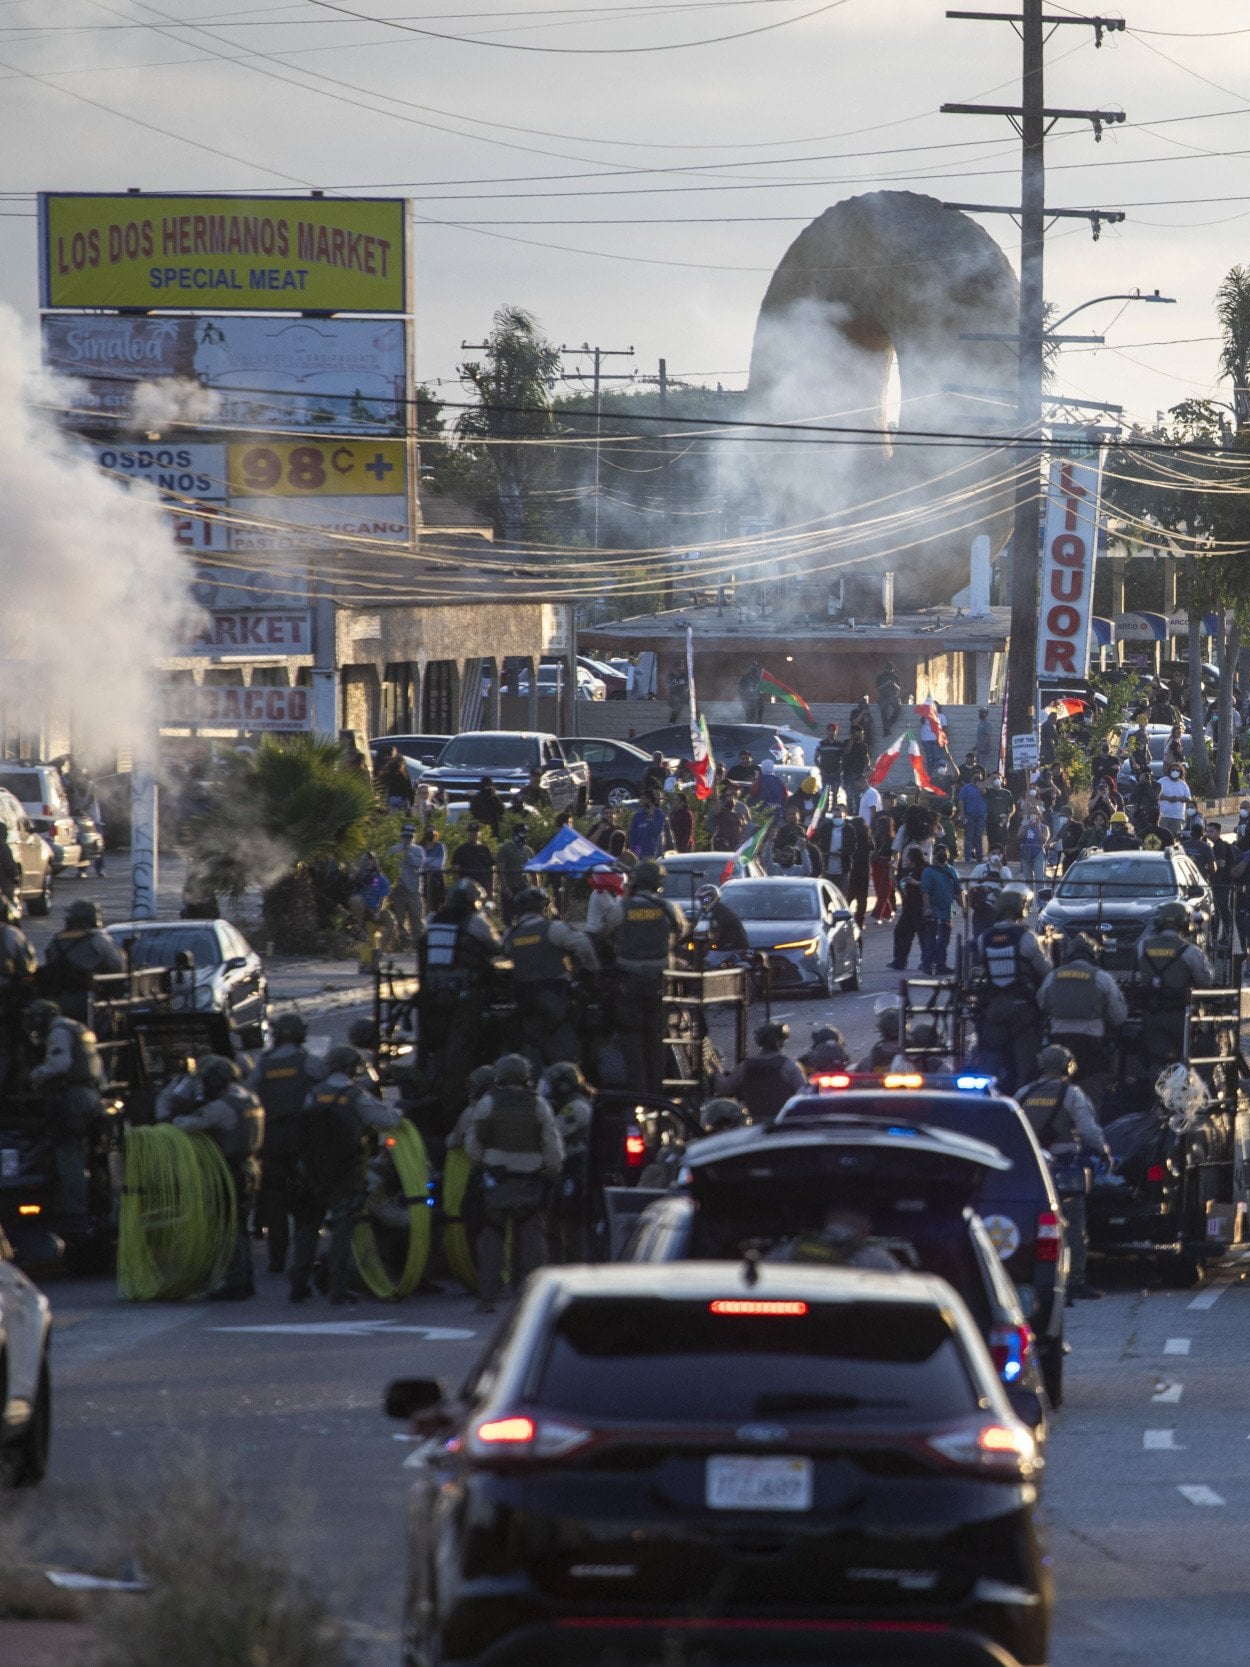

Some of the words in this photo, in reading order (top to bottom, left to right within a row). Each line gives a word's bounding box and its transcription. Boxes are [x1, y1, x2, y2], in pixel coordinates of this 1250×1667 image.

[58, 228, 100, 276] LOS
[108, 219, 154, 265] DOS
[162, 214, 290, 258] HERMANOS
[297, 221, 392, 279] MARKET
[150, 267, 242, 290] SPECIAL
[250, 269, 309, 290] MEAT
[65, 329, 164, 362] Sinaloa
[94, 450, 191, 469] OSDOS
[1044, 460, 1087, 674] LIQUOR
[160, 689, 308, 720] TOBACCO
[1056, 969, 1090, 980] SHERIFF
